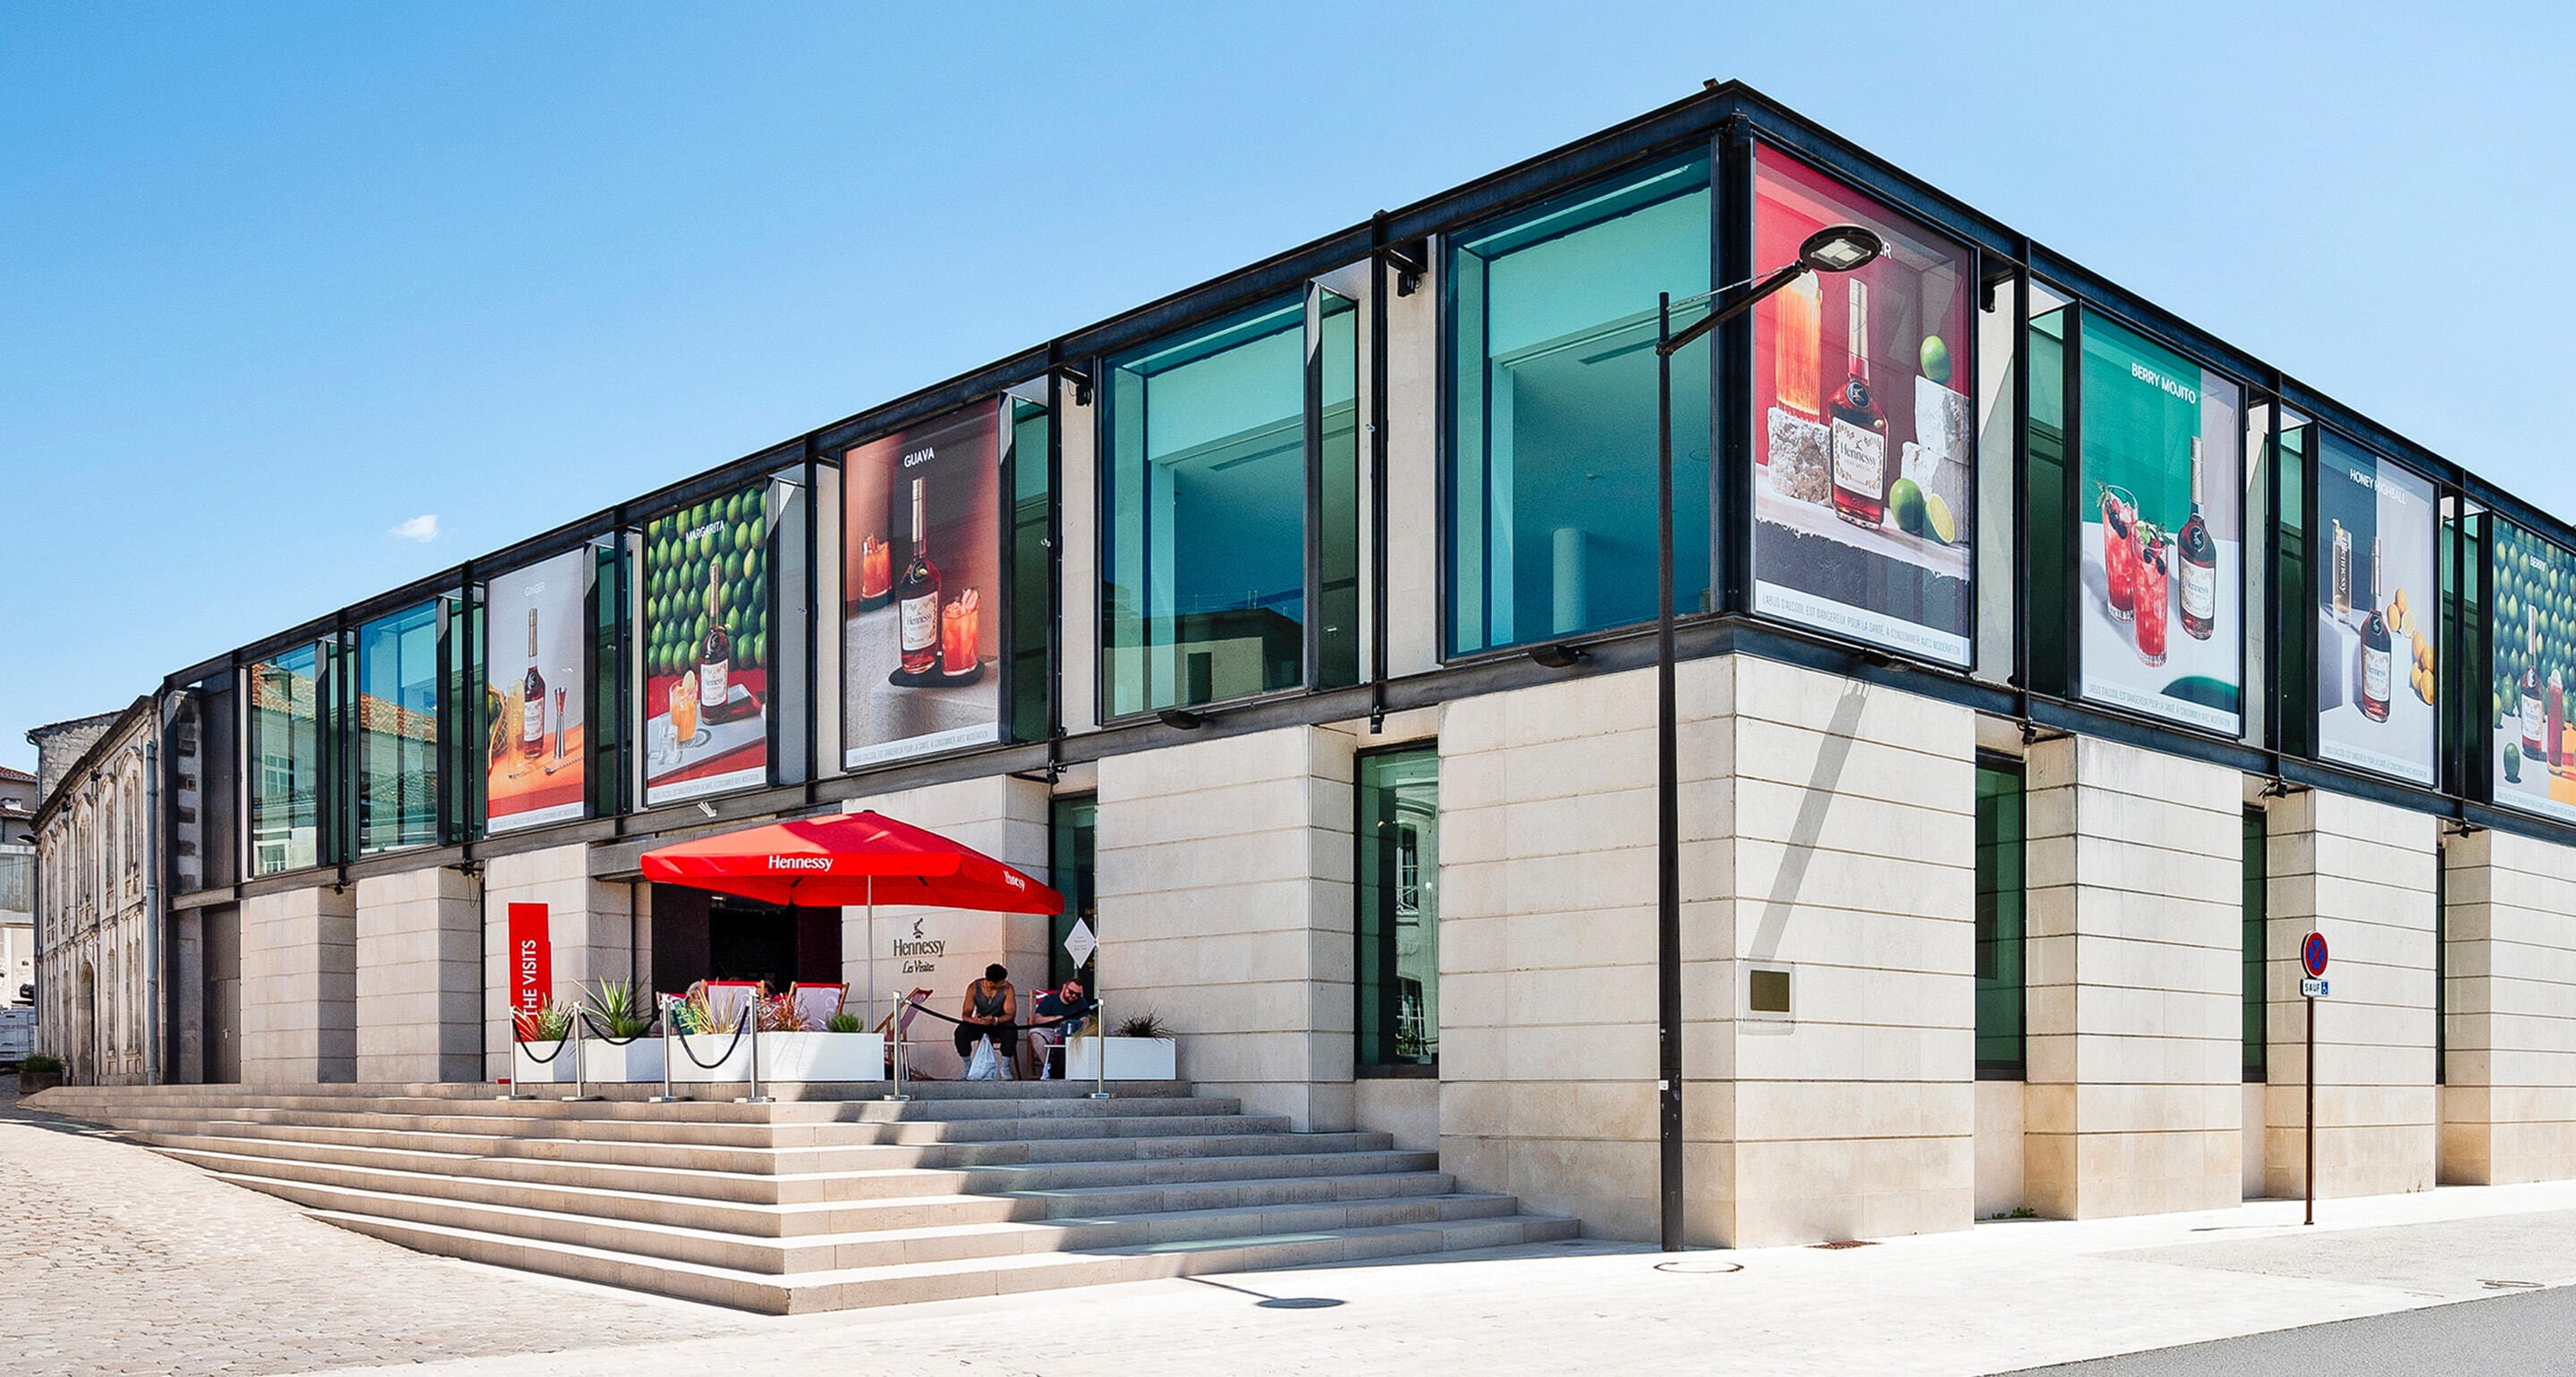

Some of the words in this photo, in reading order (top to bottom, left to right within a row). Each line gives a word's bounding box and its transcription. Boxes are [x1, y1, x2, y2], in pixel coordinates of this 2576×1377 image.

[2131, 362, 2160, 387] BERRY
[2161, 376, 2196, 404] MOJITO
[903, 447, 935, 468] GUAVA
[1840, 442, 1877, 469] Hennessy
[2350, 468, 2375, 489] HONEY
[685, 520, 725, 544] MARGARITA
[768, 855, 834, 872] Hennessy
[894, 938, 945, 958] Hennessy
[521, 940, 538, 985] VISITS
[902, 960, 914, 974] Les
[2304, 983, 2319, 993] SAUF
[522, 988, 538, 1017] THE
